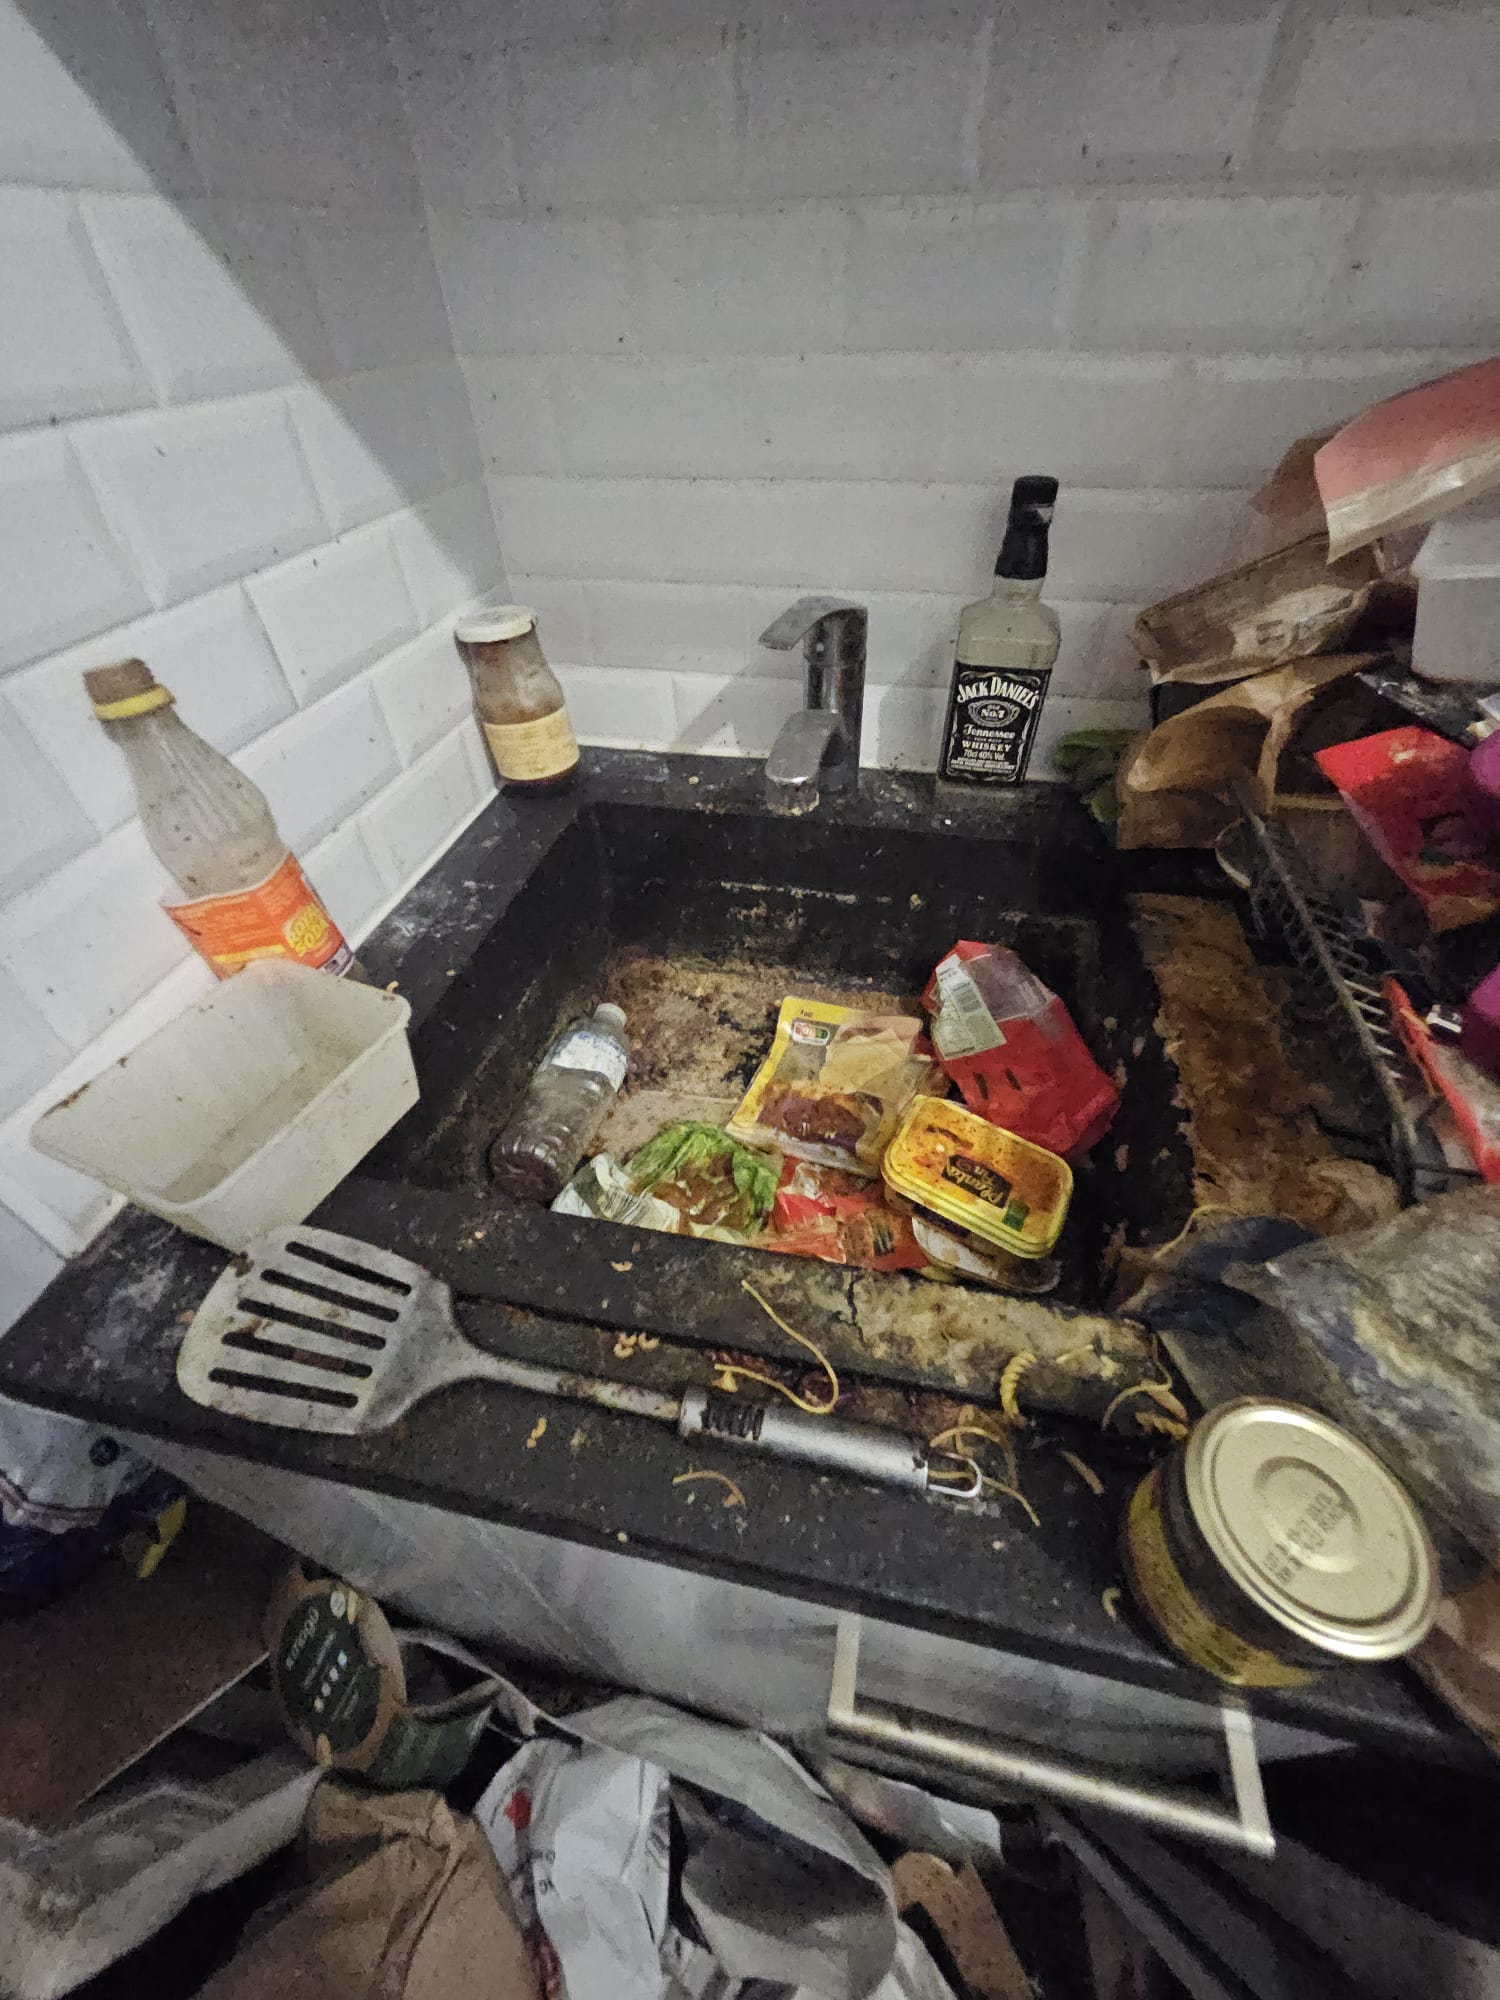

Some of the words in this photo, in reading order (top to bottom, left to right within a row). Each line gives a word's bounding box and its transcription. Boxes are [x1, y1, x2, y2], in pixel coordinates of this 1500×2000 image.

[957, 681, 989, 703] JACK
[962, 723, 1016, 739] Tennessee
[962, 740, 1012, 752] WHISKEY
